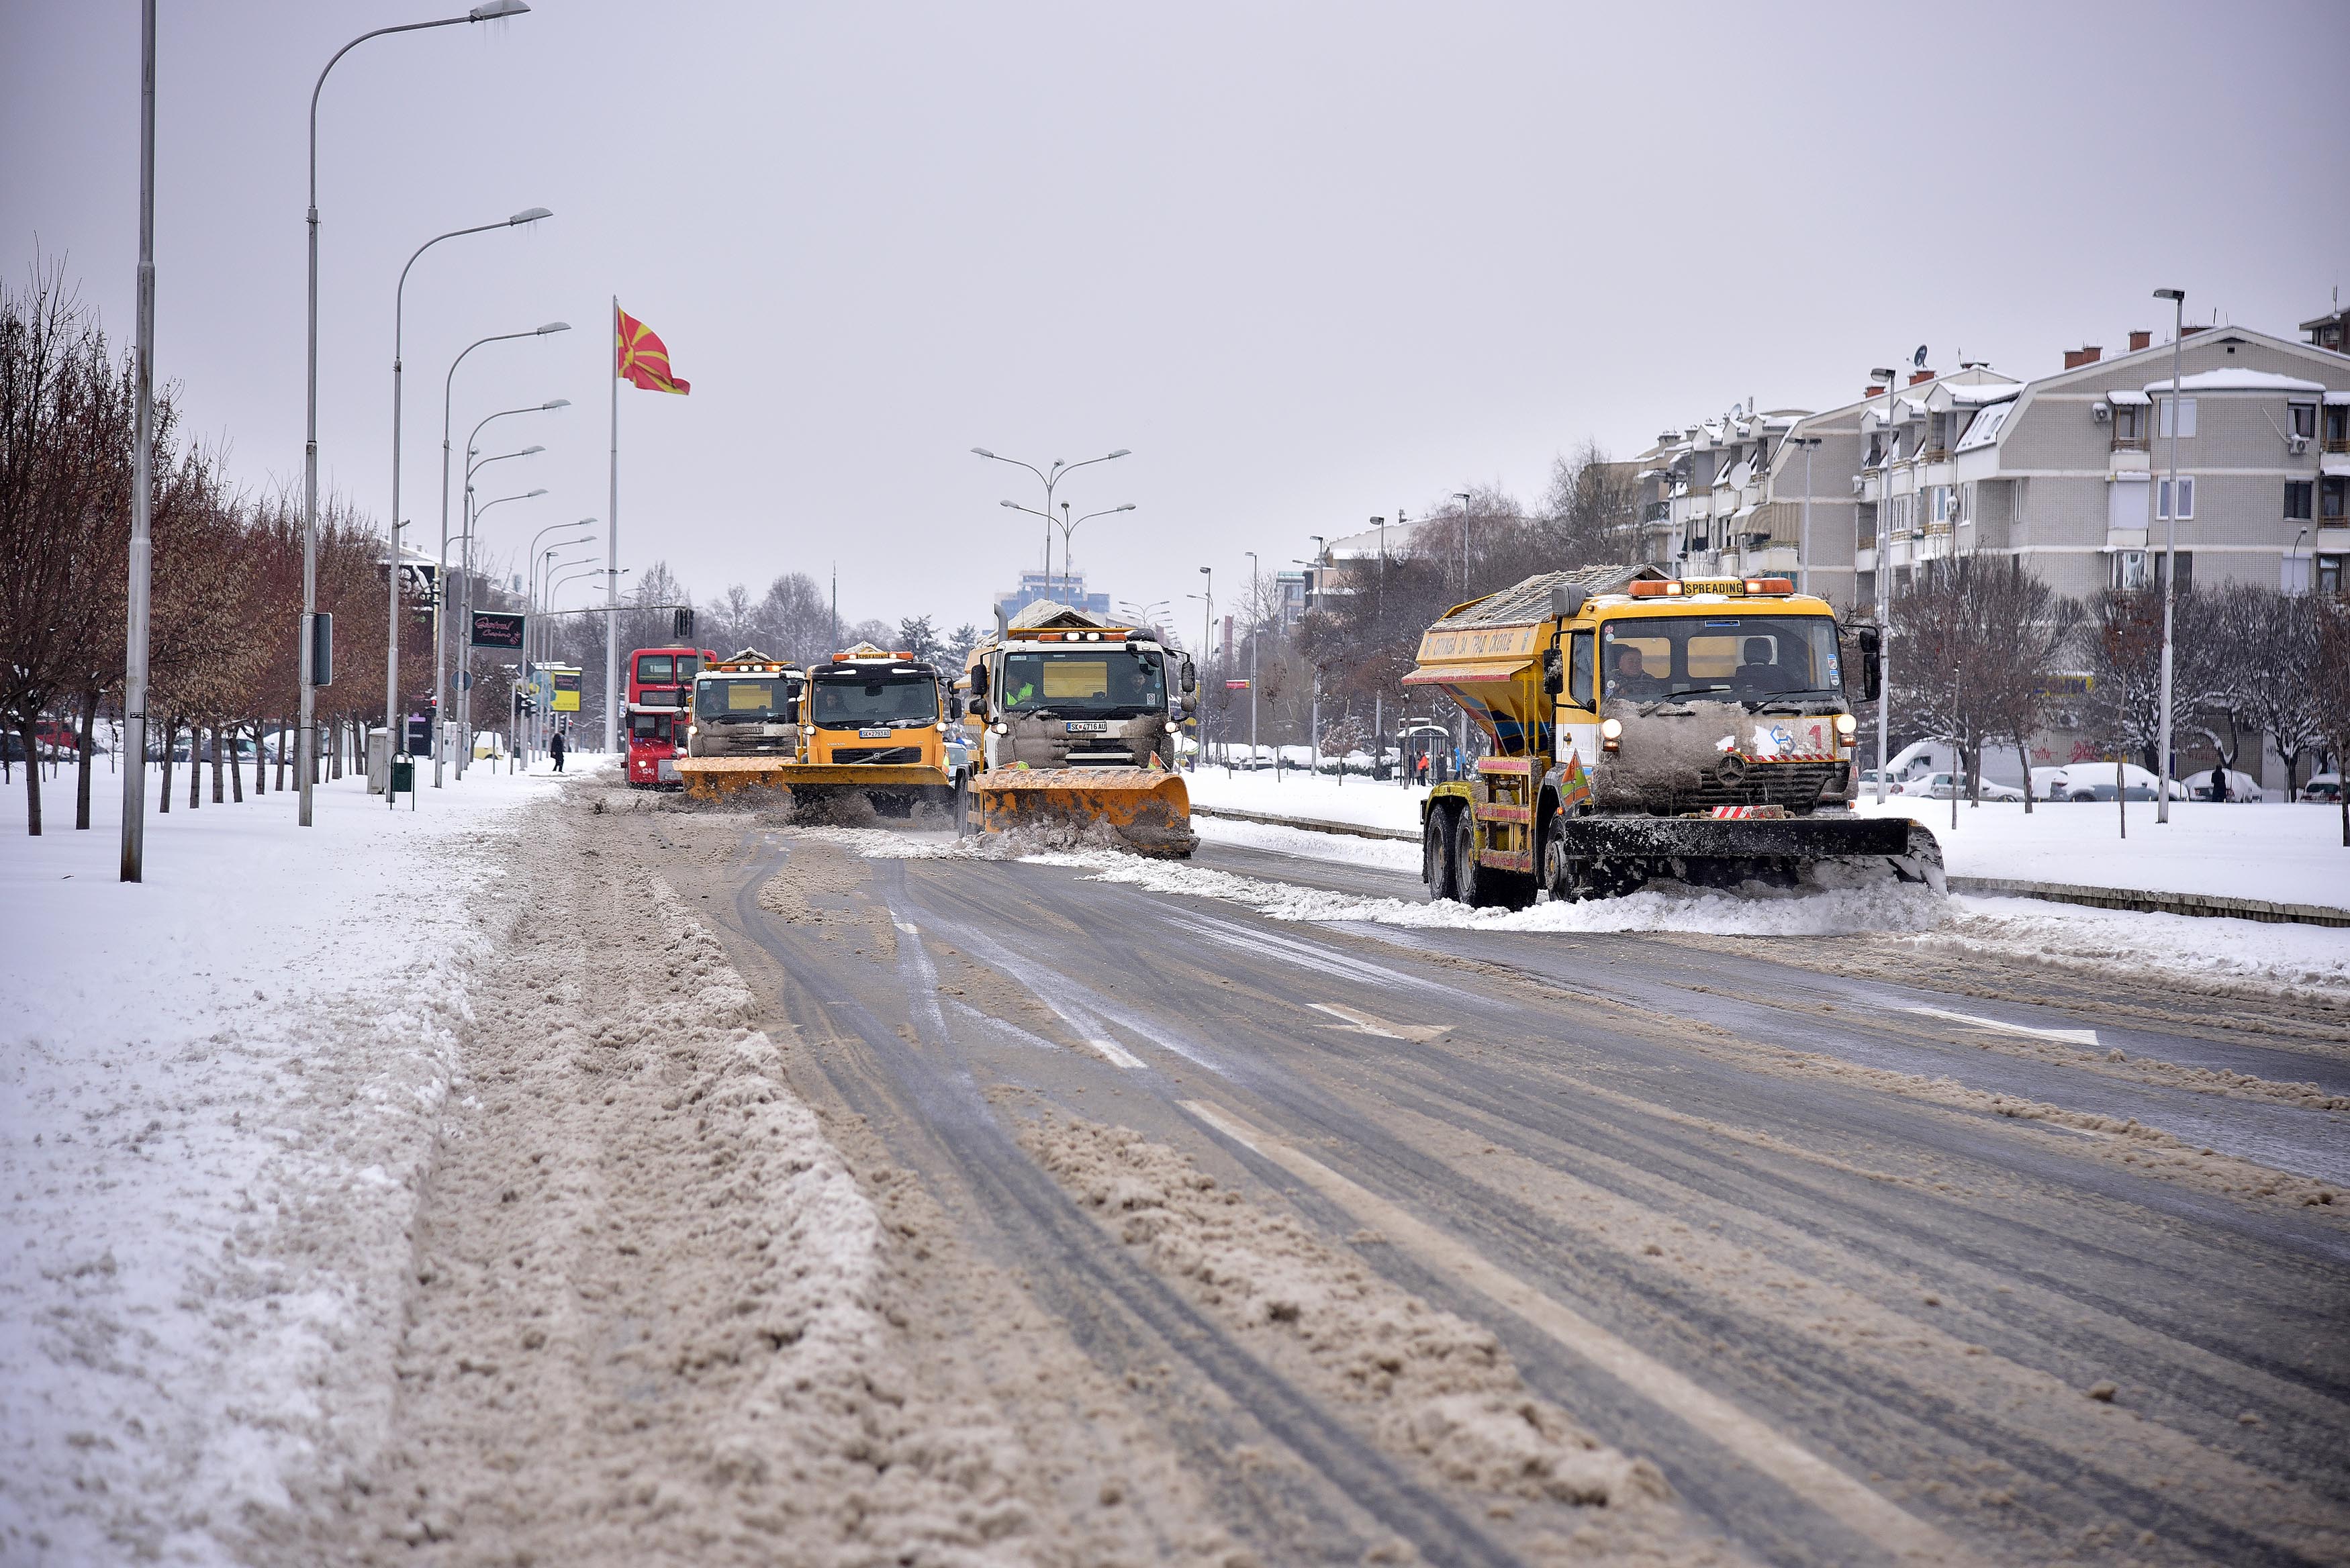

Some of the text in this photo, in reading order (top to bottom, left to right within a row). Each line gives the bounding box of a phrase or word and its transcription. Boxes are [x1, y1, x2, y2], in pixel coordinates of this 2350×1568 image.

[1685, 583, 1742, 593] SPREADING
[1433, 633, 1514, 656] СЛУЖБА ЗА ГРАД СКОПЈЕ
[1808, 725, 1822, 749] 1
